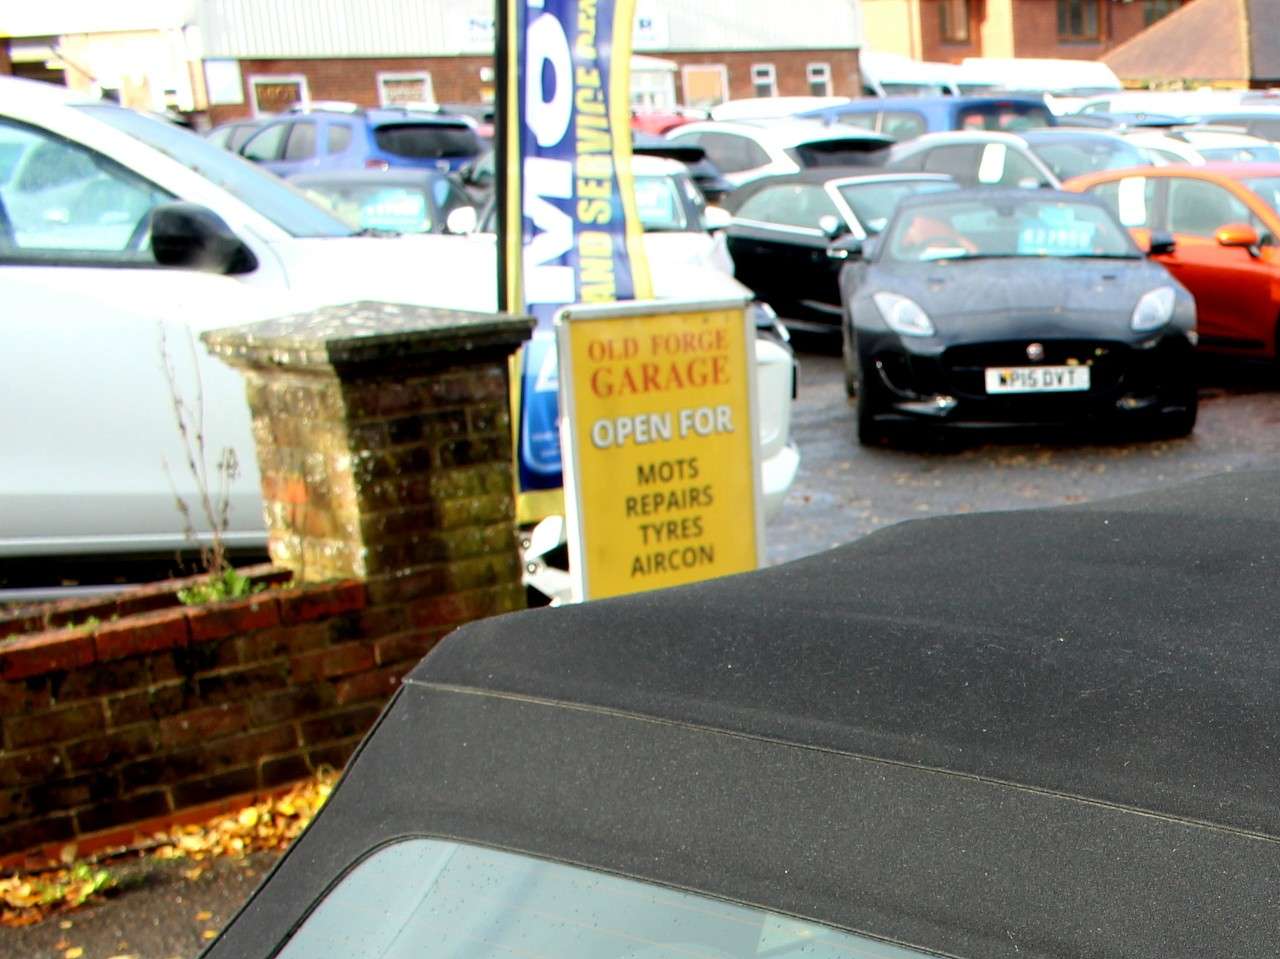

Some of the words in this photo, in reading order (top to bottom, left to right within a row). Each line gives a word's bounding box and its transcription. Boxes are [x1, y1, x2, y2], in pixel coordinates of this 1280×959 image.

[523, 0, 575, 304] MO
[575, 65, 613, 225] SERVICE
[587, 337, 639, 362] OLD
[651, 328, 730, 356] FORGE
[590, 355, 731, 399] GARAGE
[591, 411, 672, 449] OPEN
[679, 403, 735, 439] FOR
[637, 457, 699, 485] MOTS
[625, 485, 714, 517] REPAIRS
[639, 516, 704, 545] TYRES
[631, 544, 715, 578] AIRCON
